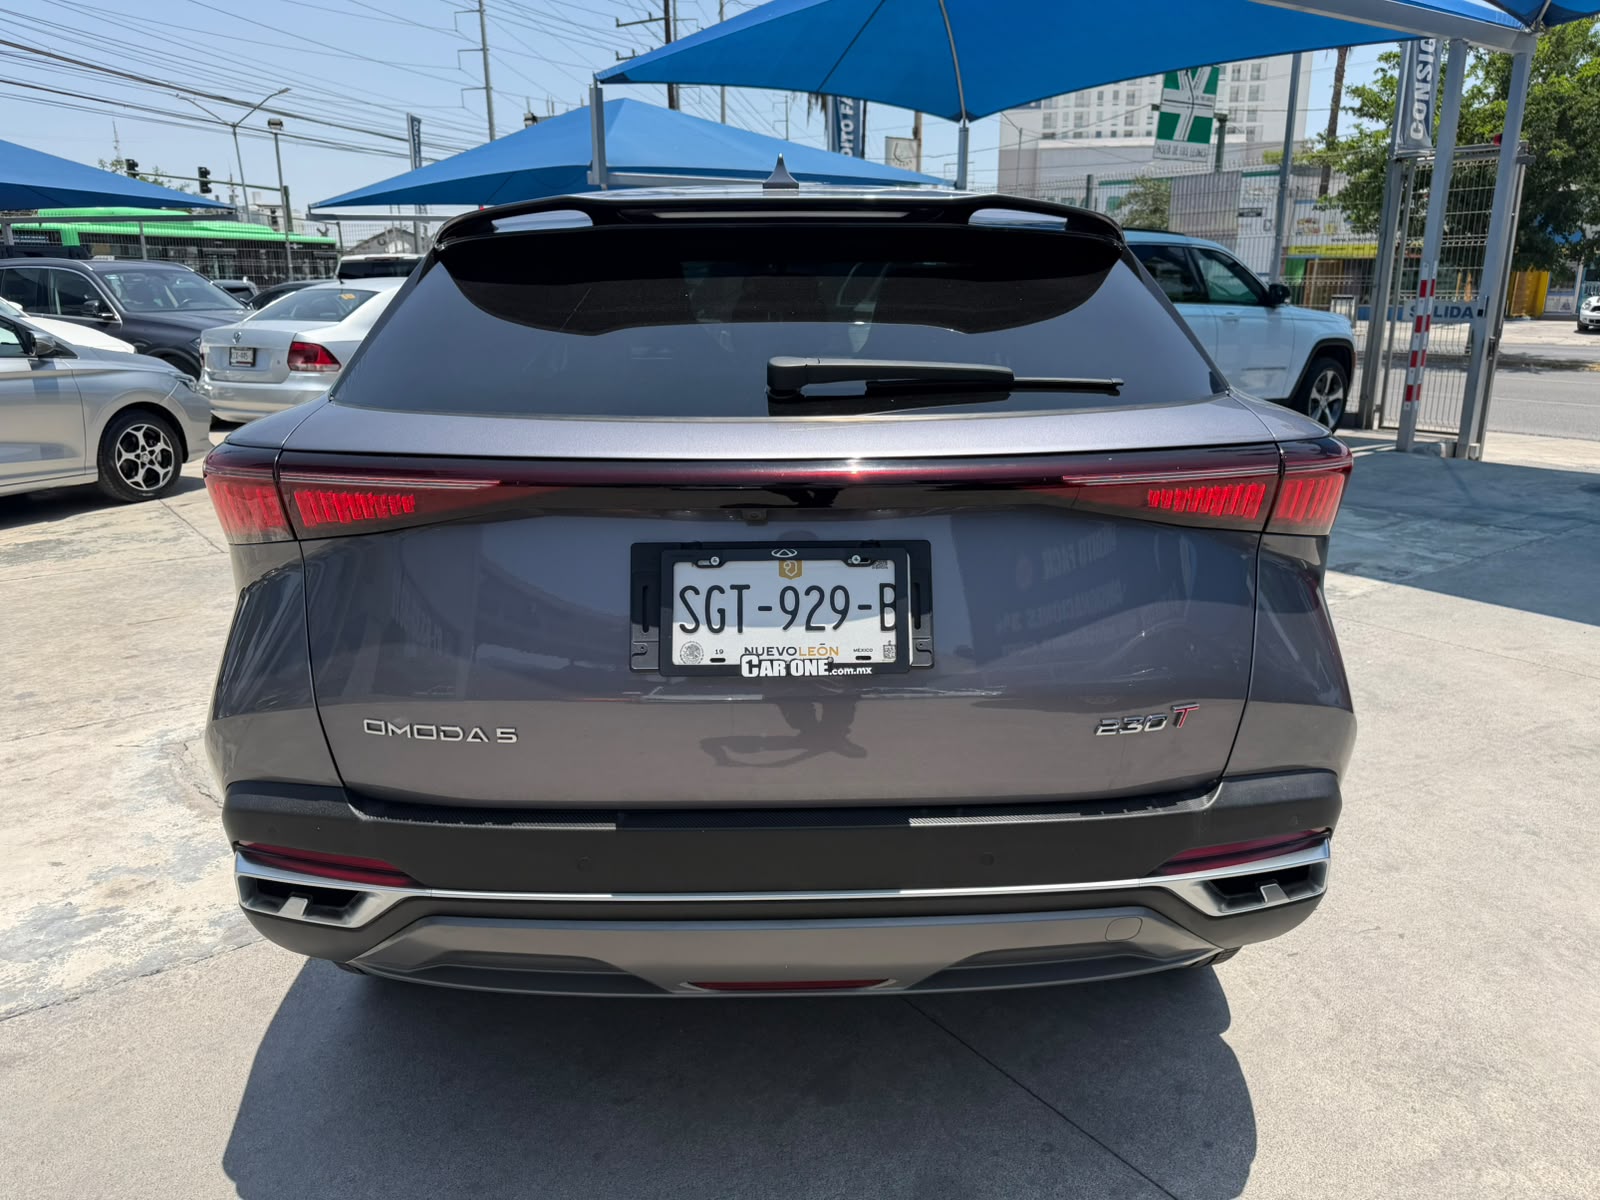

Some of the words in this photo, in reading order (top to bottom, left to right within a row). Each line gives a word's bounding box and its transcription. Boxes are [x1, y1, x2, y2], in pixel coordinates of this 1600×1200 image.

[679, 583, 896, 633] SGT-929-B
[744, 646, 797, 657] NUEVO
[363, 719, 489, 743] OMODA
[496, 728, 518, 744] 5
